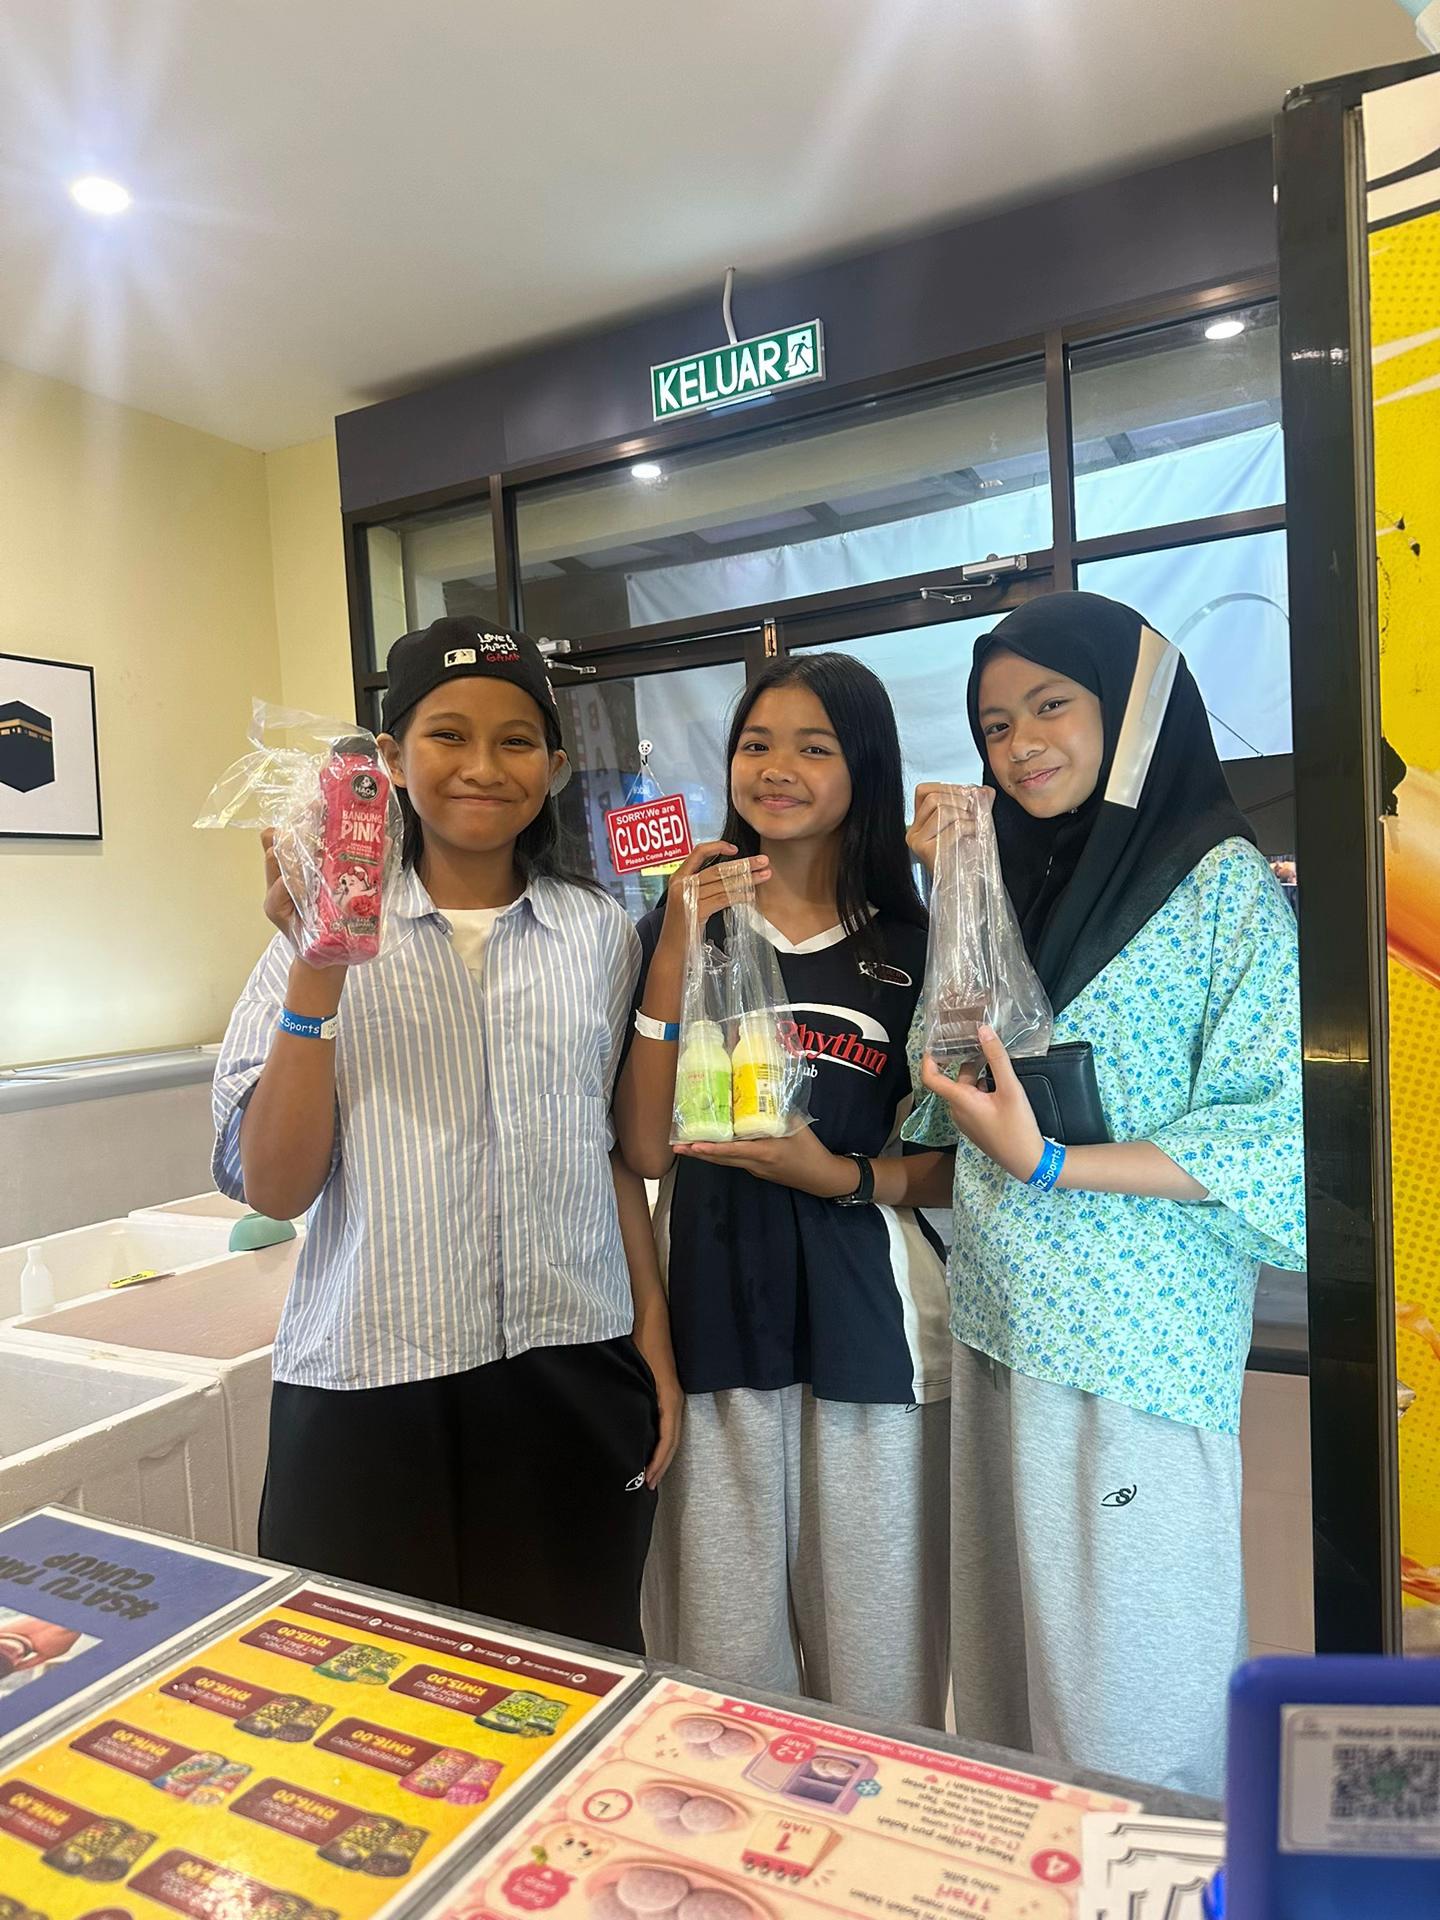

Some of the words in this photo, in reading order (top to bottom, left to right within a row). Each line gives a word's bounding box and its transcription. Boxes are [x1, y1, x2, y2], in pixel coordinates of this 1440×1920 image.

[658, 341, 782, 412] KELUAR
[342, 809, 382, 824] BANDUNG
[662, 805, 676, 814] are
[340, 820, 382, 843] PINK
[615, 815, 684, 857] CLOSED
[625, 856, 645, 866] Please
[645, 852, 663, 861] Come
[664, 848, 682, 857] Again
[776, 1020, 888, 1075] Rhythm
[43, 1553, 155, 1591] CUKUP
[39, 1577, 160, 1620] #SATU
[277, 1627, 331, 1647] RM15.00
[194, 1677, 253, 1702] RM16.00
[426, 1673, 488, 1696] RM15.00
[441, 1688, 480, 1704] CRUNCH
[422, 1691, 461, 1705] MATCHA
[351, 1730, 416, 1757] RM16.00
[784, 1738, 811, 1749] HARI
[272, 1789, 339, 1821] RM16.00
[777, 1819, 812, 1835] HARI
[877, 1816, 909, 1832] boleh
[775, 1832, 791, 1852] 1
[1045, 1854, 1069, 1877] 4
[935, 1884, 977, 1908] hari
